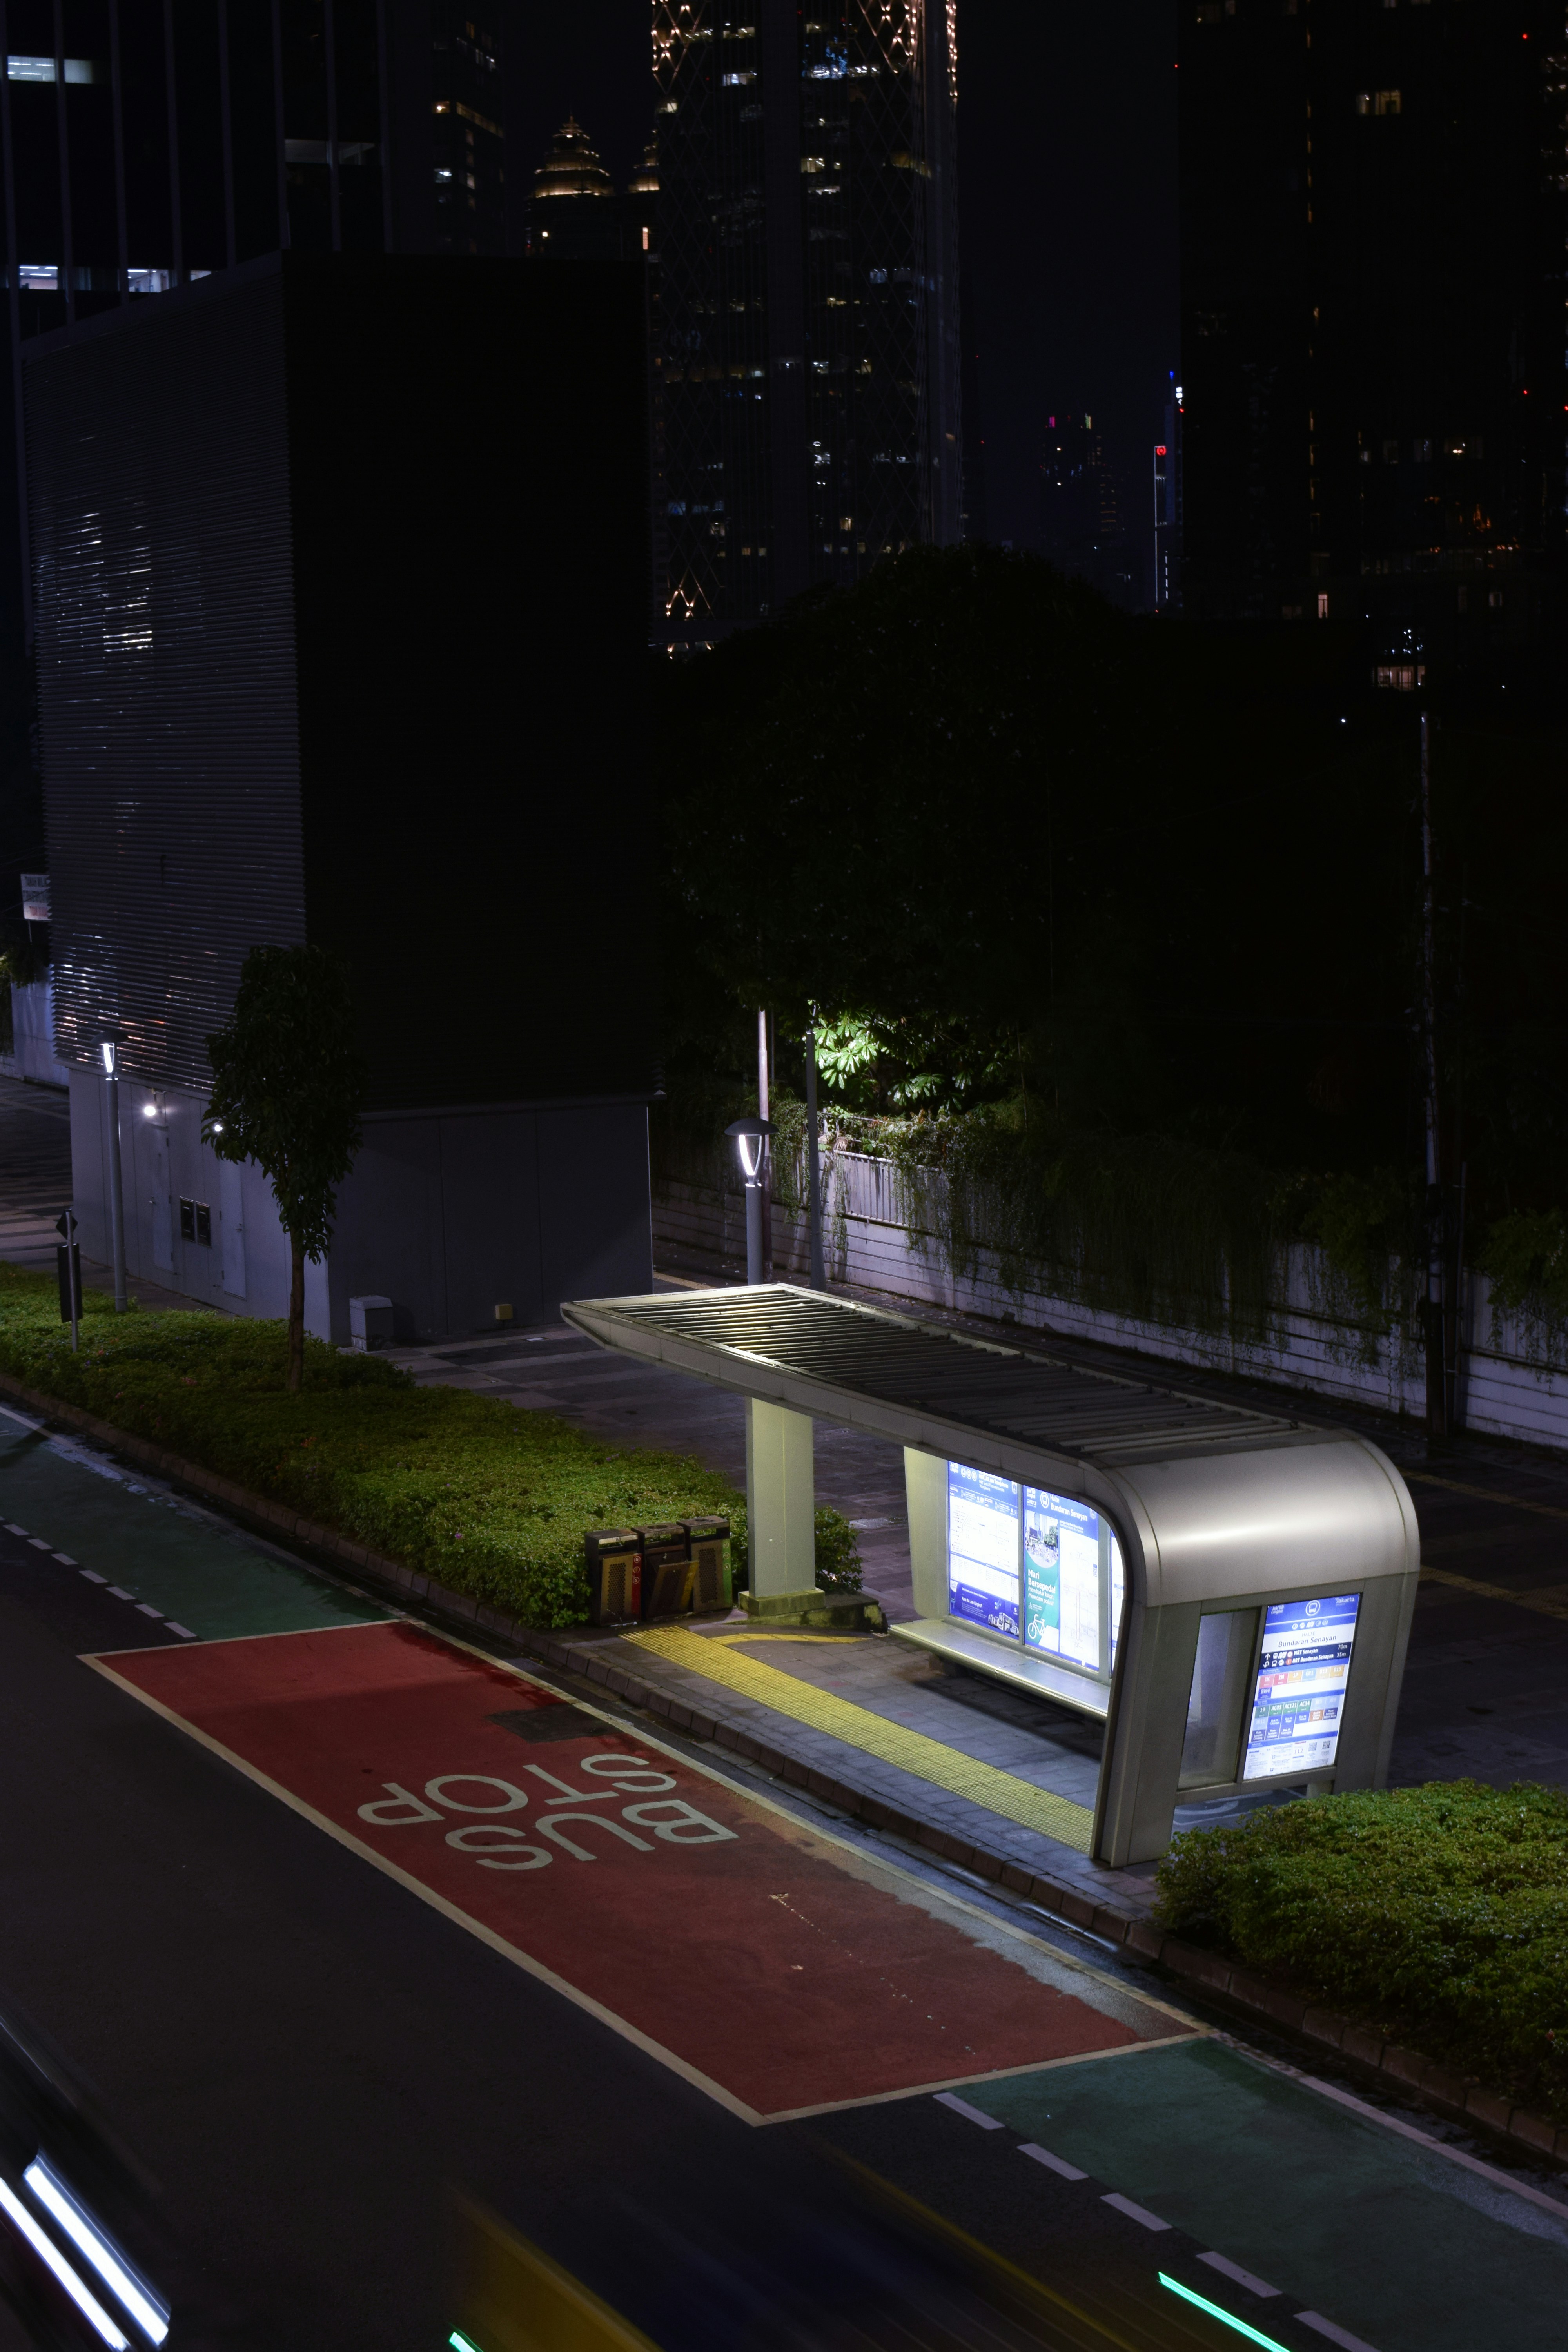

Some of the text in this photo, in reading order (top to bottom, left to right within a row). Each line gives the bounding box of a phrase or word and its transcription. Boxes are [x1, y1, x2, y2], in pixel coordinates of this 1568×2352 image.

[1050, 1494, 1060, 1503] Halte
[1050, 1502, 1087, 1521] Bundaran Senayan
[1028, 1569, 1039, 1579] Mari
[1028, 1577, 1056, 1593] Bersepeda!
[1278, 1635, 1337, 1648] Bundaran Senayan
[357, 1754, 677, 1825] STOP
[445, 1799, 740, 1870] BUS
